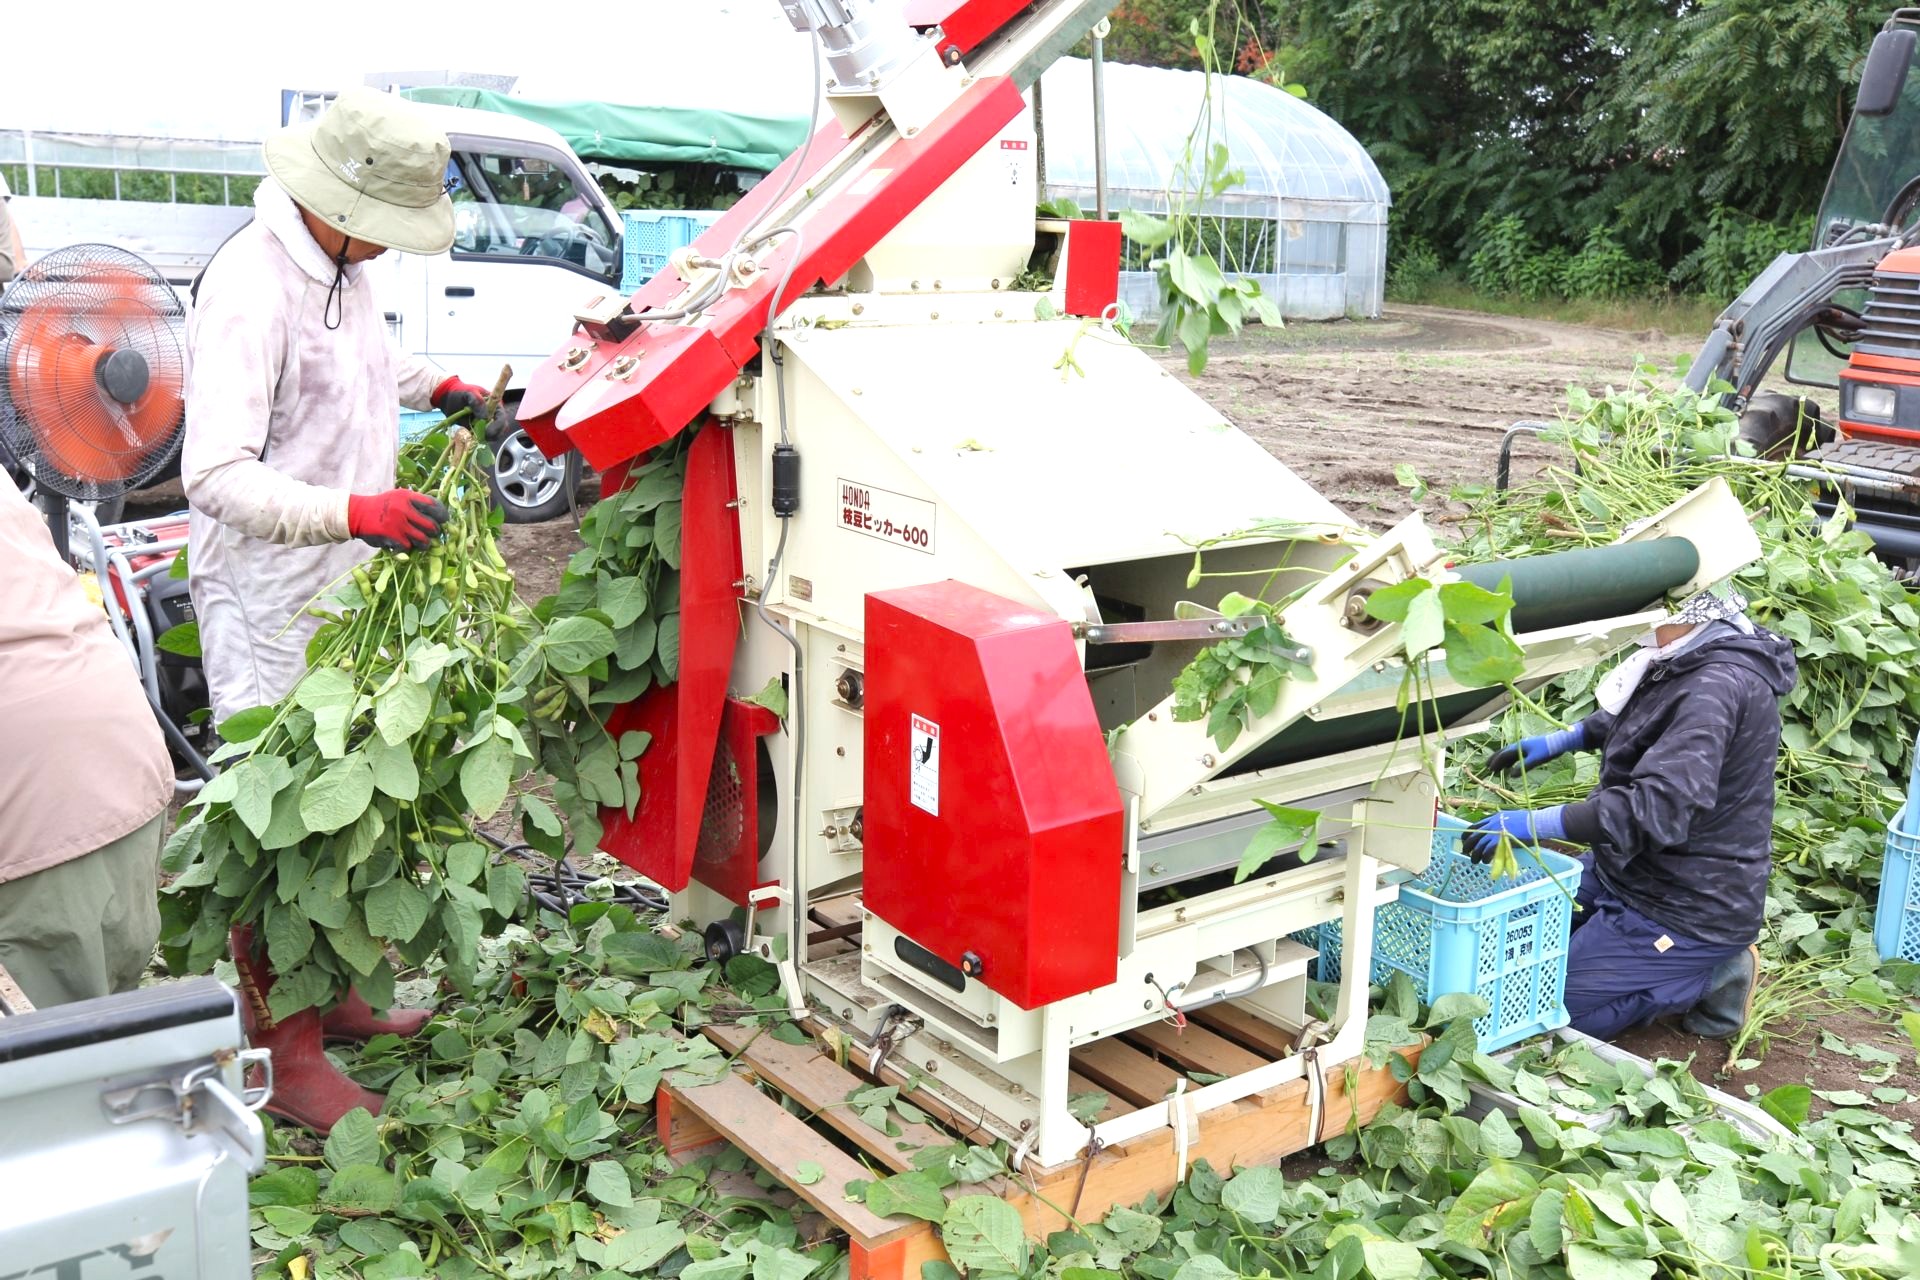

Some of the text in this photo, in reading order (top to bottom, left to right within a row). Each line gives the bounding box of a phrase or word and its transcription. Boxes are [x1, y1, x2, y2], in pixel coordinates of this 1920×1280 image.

[843, 484, 870, 511] HONDA
[843, 507, 928, 547] 枝豆ピッカー600
[1506, 925, 1533, 944] 260053
